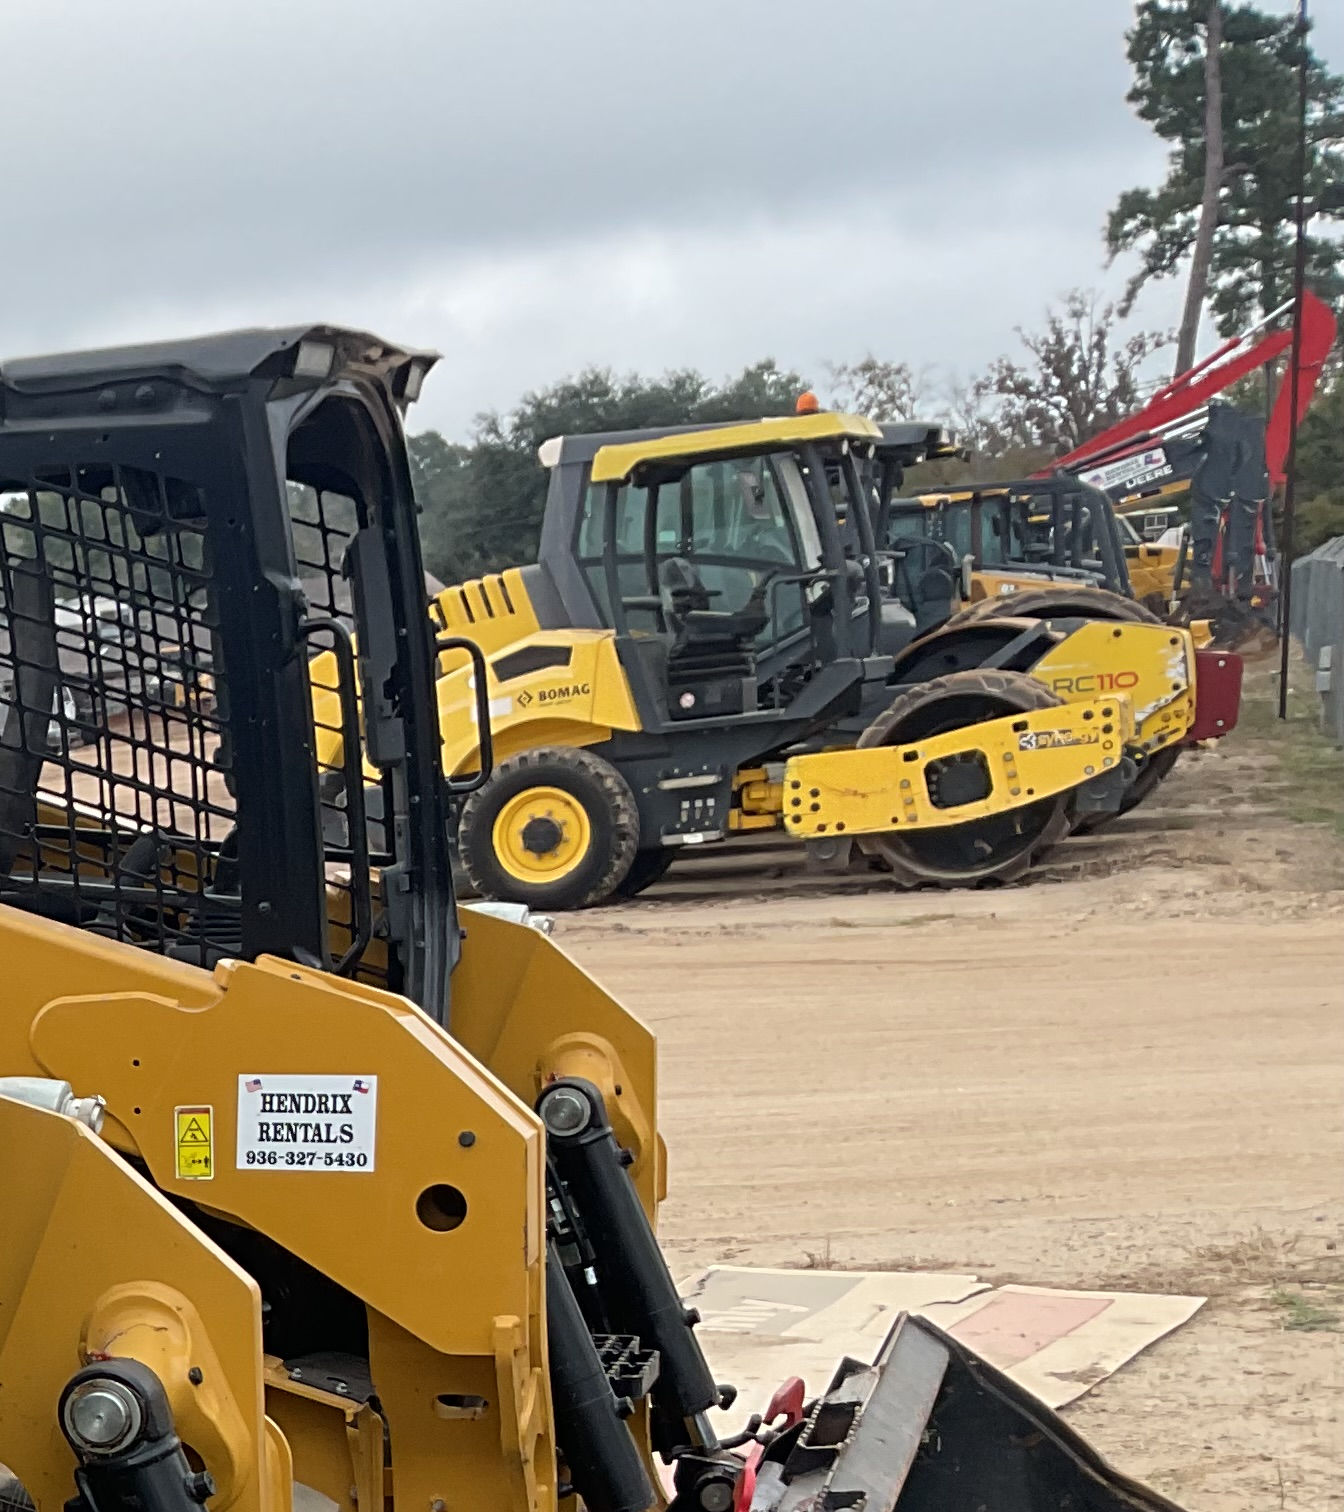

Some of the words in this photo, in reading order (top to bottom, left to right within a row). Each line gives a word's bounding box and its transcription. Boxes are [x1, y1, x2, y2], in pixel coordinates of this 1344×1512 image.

[1125, 464, 1173, 489] DEERE
[538, 683, 591, 702] BOMAG
[260, 1093, 353, 1114] HENDRIX
[257, 1121, 354, 1144] RENTALS
[246, 1150, 368, 1167] 936-327-5430
